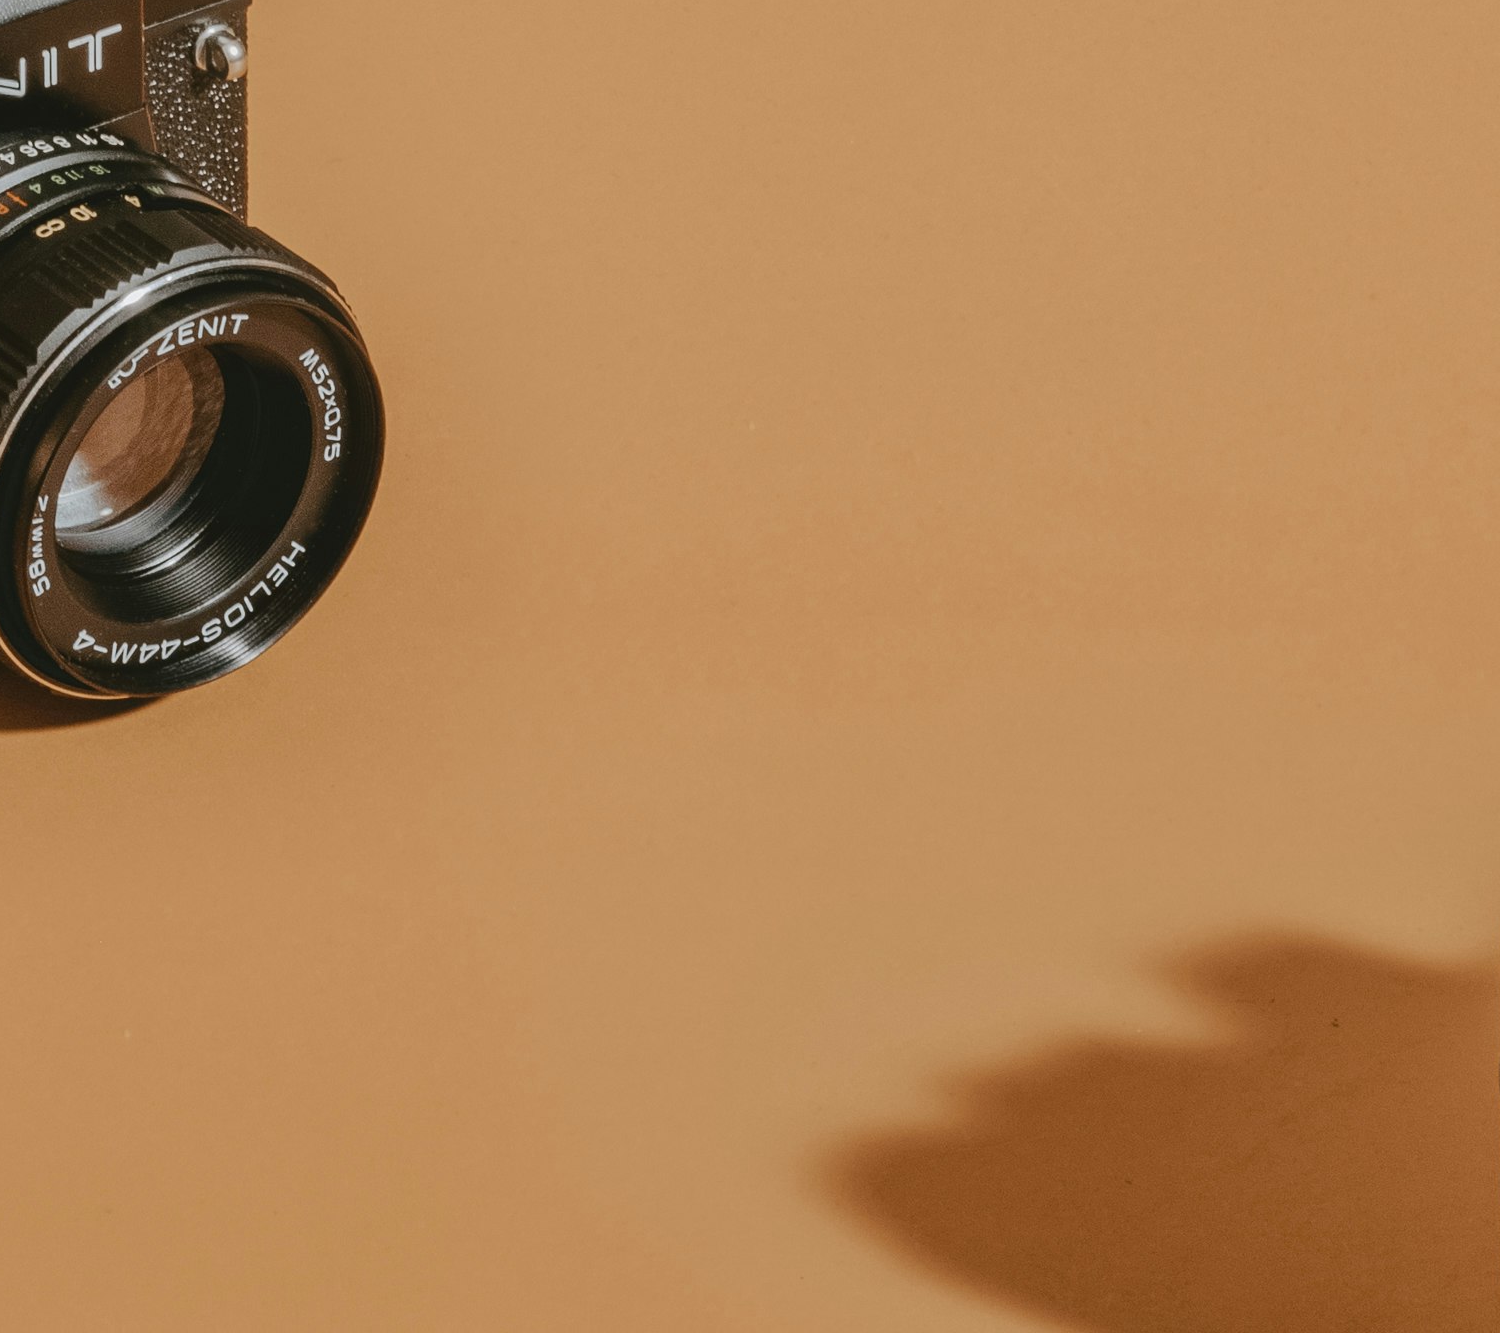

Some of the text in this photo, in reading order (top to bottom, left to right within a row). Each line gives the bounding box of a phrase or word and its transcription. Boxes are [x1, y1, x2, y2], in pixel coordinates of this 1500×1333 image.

[20, 139, 55, 157] 5,6
[53, 135, 72, 148] 8
[0, 151, 16, 165] 4
[70, 203, 98, 221] 10
[157, 314, 250, 356] ZENIT
[299, 348, 342, 463] M52x0,75
[73, 540, 306, 664] HELIOS-44M-4
